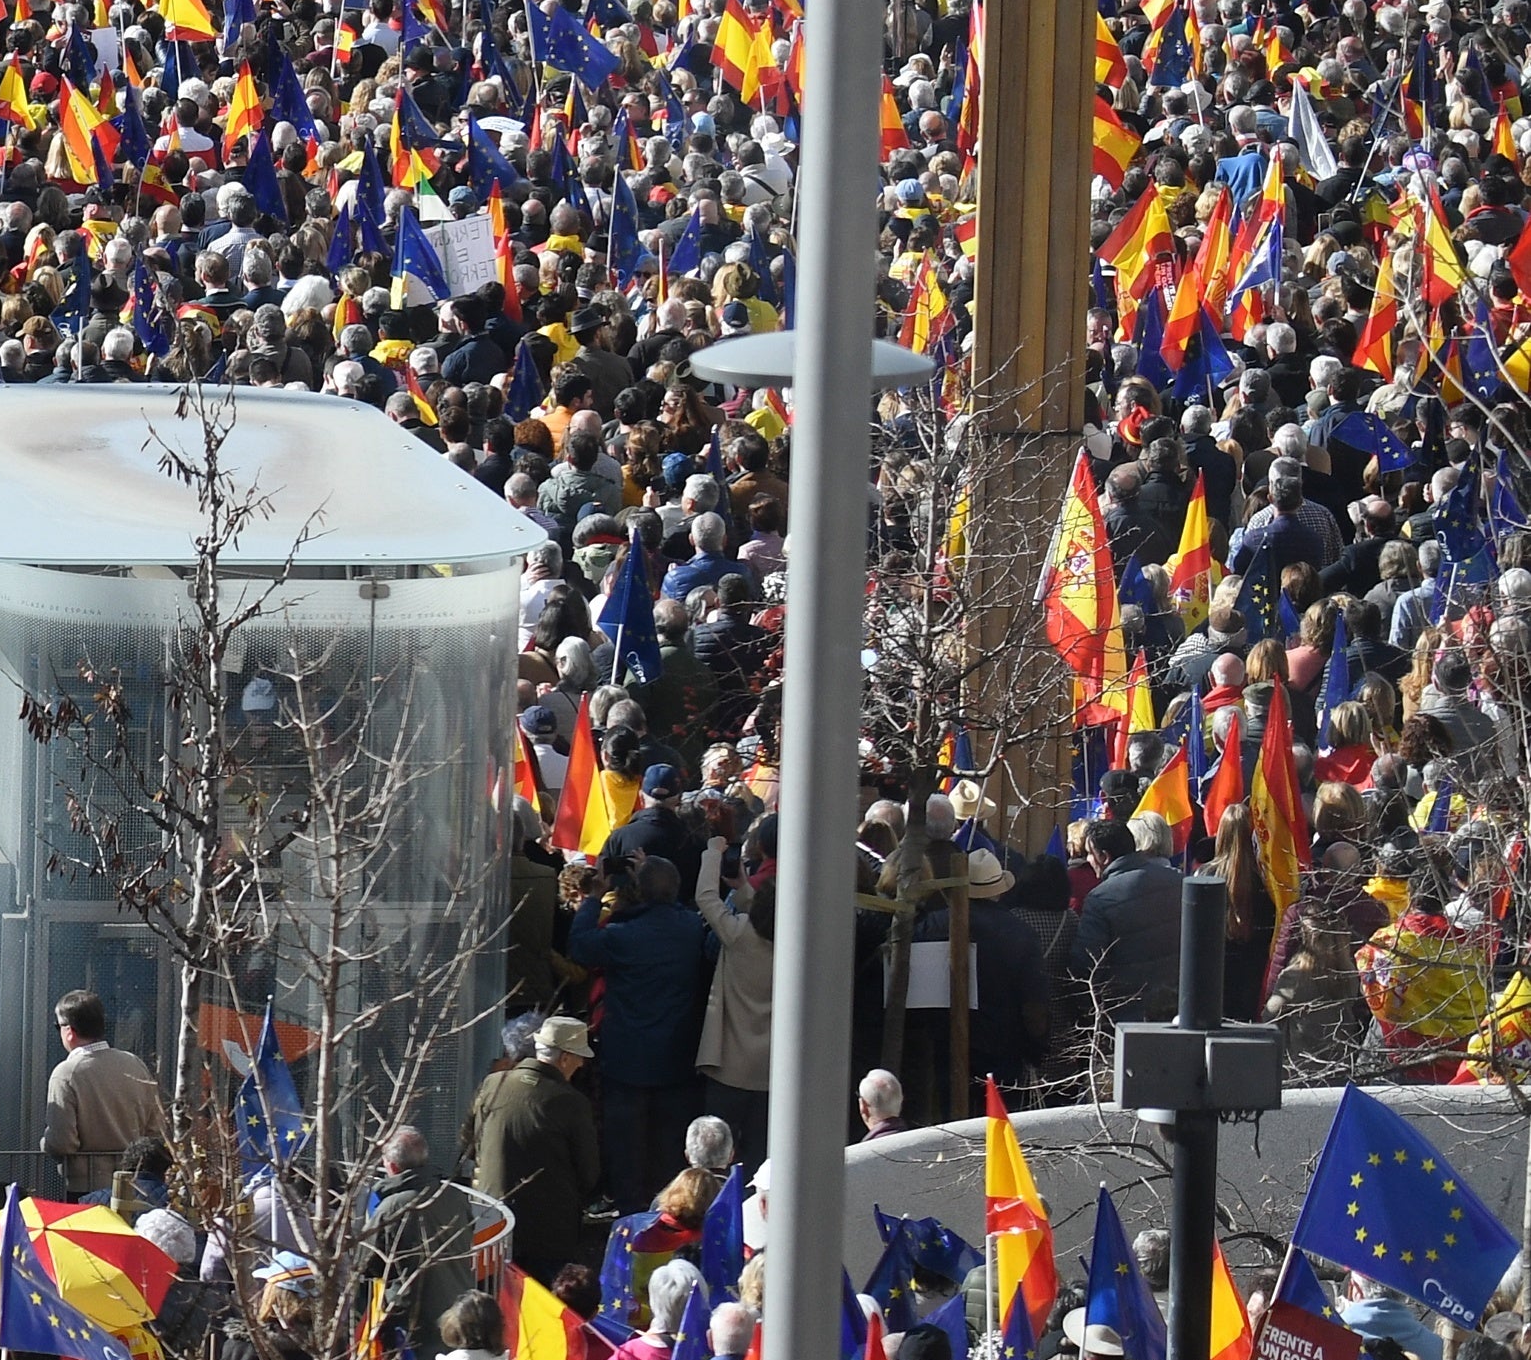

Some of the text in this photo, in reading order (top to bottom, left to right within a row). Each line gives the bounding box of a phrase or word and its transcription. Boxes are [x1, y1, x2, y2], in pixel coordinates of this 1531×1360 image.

[1440, 1295, 1476, 1323] ppe
[1259, 1342, 1280, 1360] UN
[1264, 1325, 1313, 1357] FRENTE
